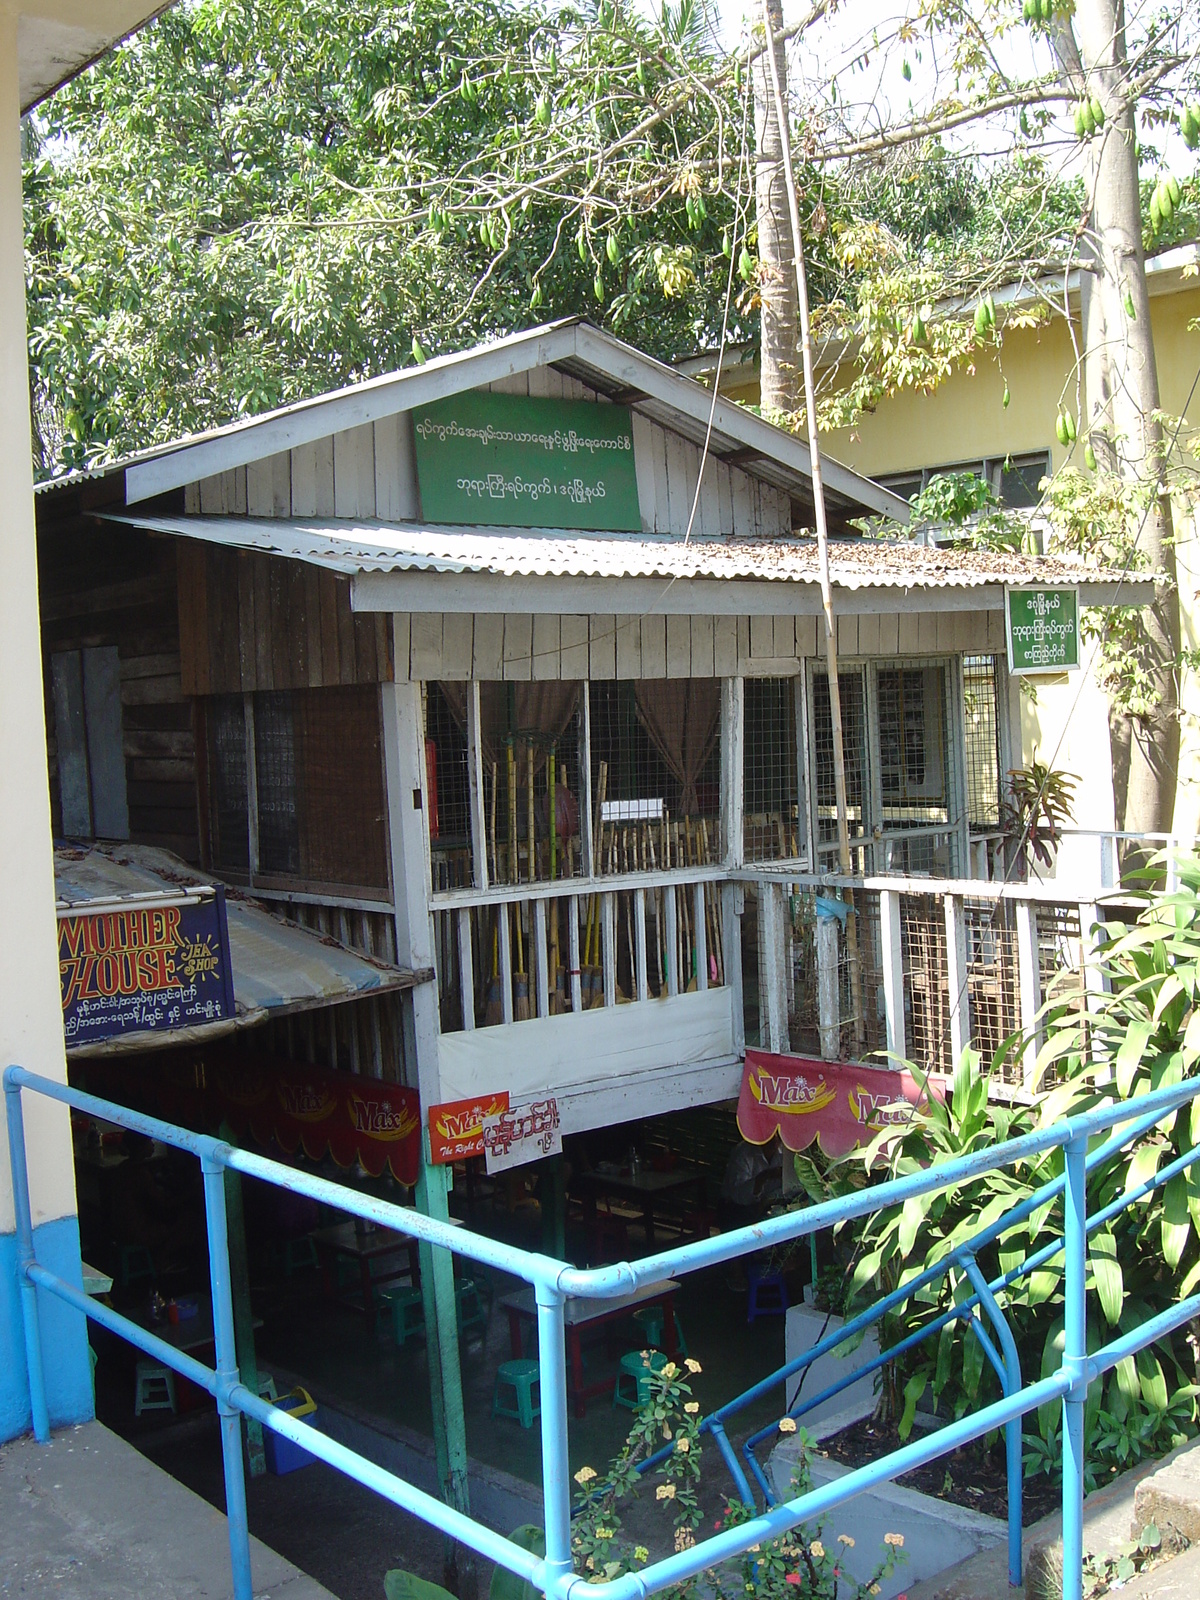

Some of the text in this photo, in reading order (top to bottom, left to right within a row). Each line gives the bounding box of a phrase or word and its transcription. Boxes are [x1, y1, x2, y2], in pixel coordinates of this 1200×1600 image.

[1026, 593, 1060, 615] ဒဂုံမြို့နယ်
[1012, 619, 1074, 642] ဘုရားကြီးရပ်ကွက်
[1024, 643, 1066, 664] စာကြည့်တိုက်
[57, 906, 185, 958] MOTHER
[180, 942, 212, 962] TEA
[59, 946, 185, 1010] HOUSE
[183, 957, 220, 976] SHOP
[283, 1085, 322, 1114] Max
[758, 1076, 817, 1106] Max
[354, 1100, 401, 1133] Max
[439, 1146, 453, 1157] The
[454, 1141, 475, 1155] Right
